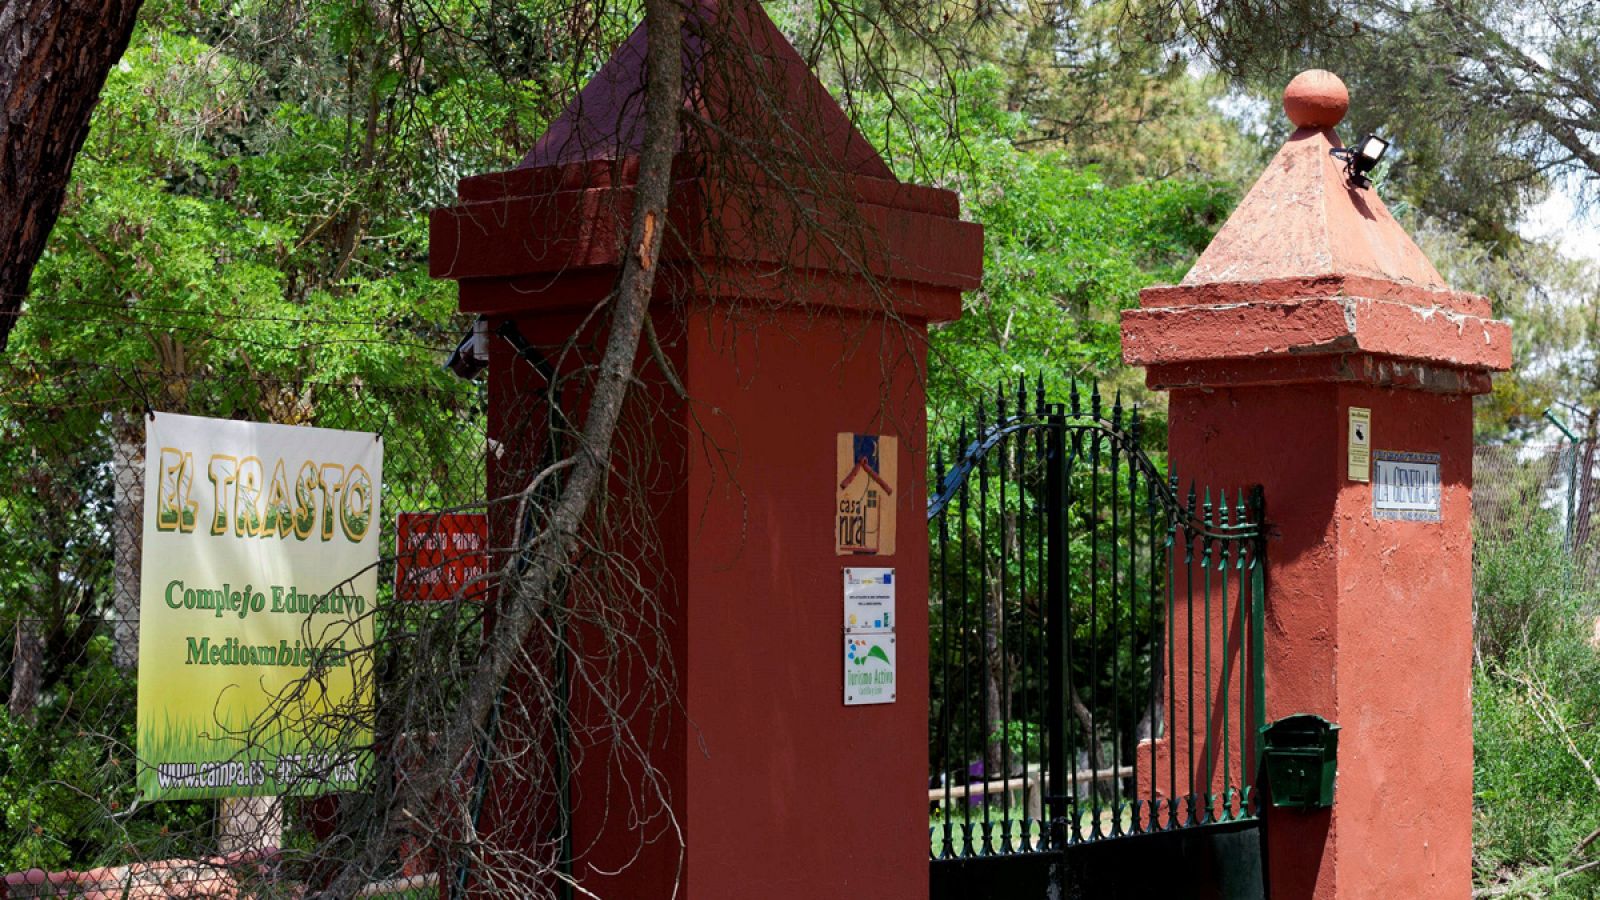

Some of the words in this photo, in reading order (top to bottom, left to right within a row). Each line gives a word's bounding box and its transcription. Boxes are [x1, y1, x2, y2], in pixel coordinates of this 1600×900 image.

[158, 448, 199, 533] EL
[208, 454, 372, 543] TRASTO
[840, 499, 861, 514] casa
[165, 579, 265, 618] Complejo
[271, 585, 365, 614] Educativo
